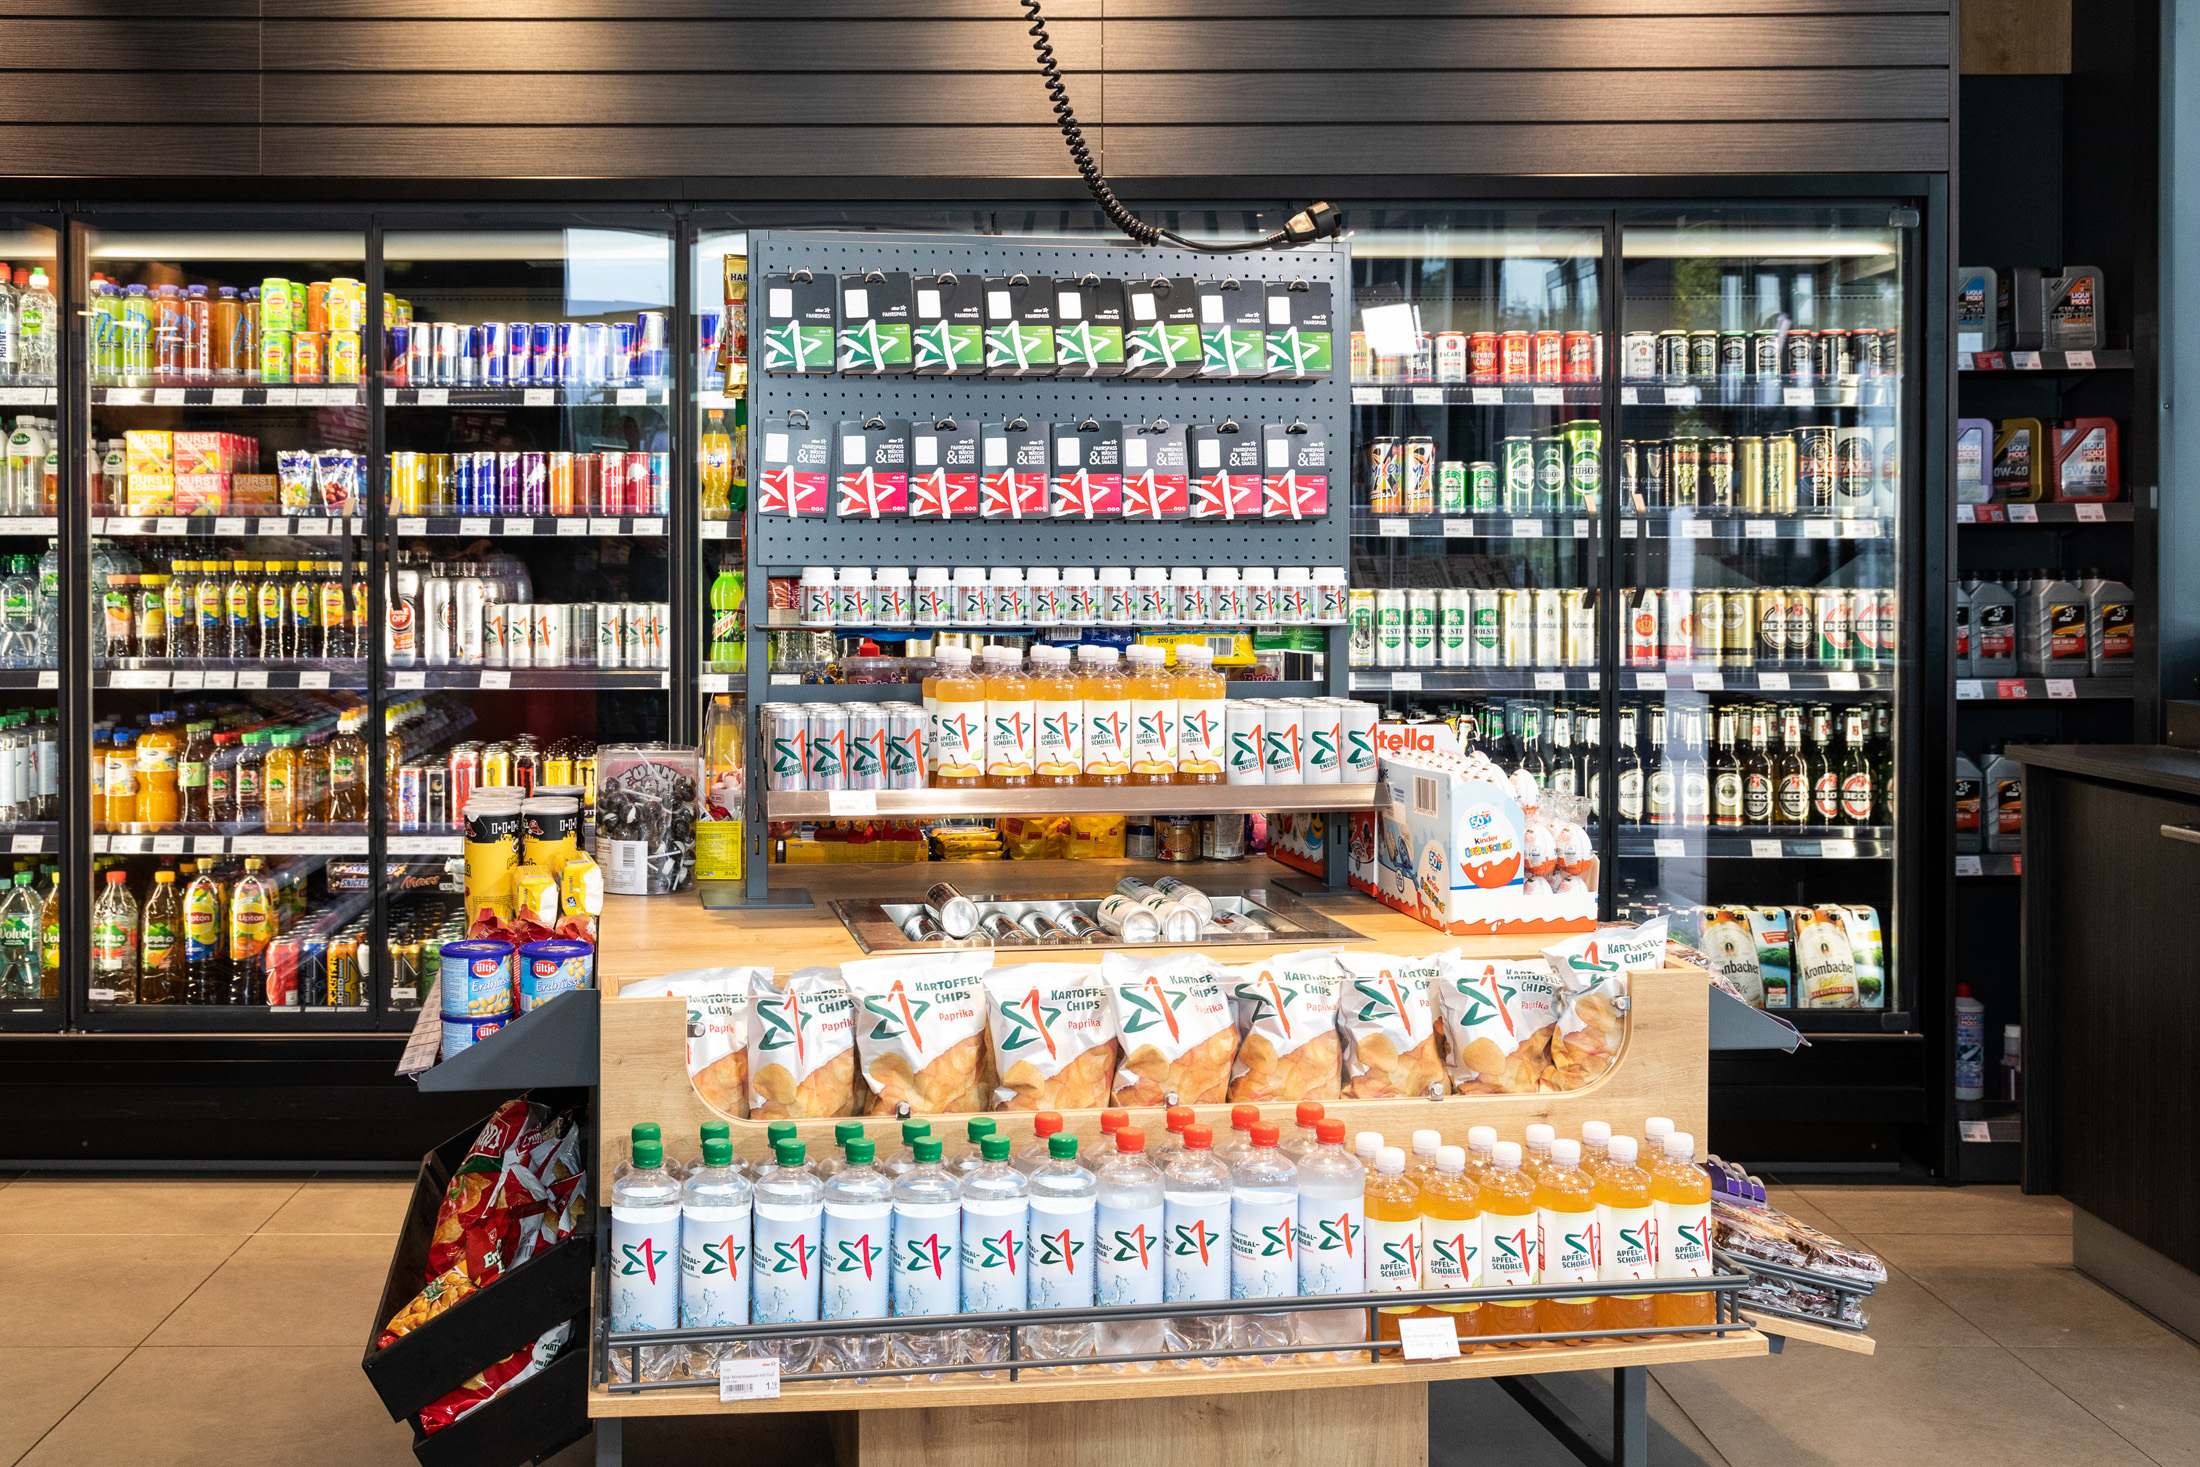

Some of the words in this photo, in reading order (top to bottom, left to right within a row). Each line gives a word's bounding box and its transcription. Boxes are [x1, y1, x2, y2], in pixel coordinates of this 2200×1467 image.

[730, 273, 747, 282] HAR
[22, 316, 43, 326] Volvic
[805, 312, 830, 320] FAHRSPASS
[1475, 358, 1492, 366] Club
[797, 450, 808, 464] &
[876, 450, 887, 464] &
[947, 451, 958, 464] &
[1017, 452, 1028, 465] &
[1089, 452, 1101, 465] &
[1570, 466, 1602, 475] TUBOR
[1801, 460, 1836, 474] FAXE
[1838, 461, 1872, 473] FAXE
[1994, 467, 2028, 477] 0W-40
[2064, 466, 2106, 476] 5W-40
[131, 475, 170, 484] DURST
[235, 477, 273, 485] DURST
[940, 740, 962, 748] SCHORLE
[994, 739, 1018, 748] SCHORLE
[1378, 728, 1435, 750] tella
[1243, 757, 1258, 765] PURE
[1279, 756, 1293, 764] PURE
[1325, 756, 1338, 764] PURE
[1356, 760, 1376, 769] ENERGY
[1360, 755, 1375, 764] PURE
[787, 763, 802, 771] PURE
[826, 763, 842, 772] PURE
[865, 762, 880, 771] PURE
[901, 761, 916, 770] PURE
[1238, 762, 1260, 772] ENERGY
[1274, 761, 1295, 770] ENERGY
[1320, 761, 1338, 770] ENERGY
[618, 764, 684, 790] FUNN
[782, 769, 803, 778] ENERGY
[821, 769, 842, 778] ENERGY
[860, 768, 882, 777] ENERGY
[896, 768, 918, 776] ENERGY
[400, 876, 440, 889] Mars
[238, 913, 265, 923] Lipton
[1608, 940, 1664, 954] KARTOFFEL-
[1624, 952, 1656, 964] CHIPS
[476, 964, 497, 974] ültje
[536, 964, 556, 974] ültje
[1804, 960, 1854, 980] Krombacher
[472, 977, 512, 992] Erdnüss
[536, 978, 583, 992] Erdnüsse
[916, 975, 982, 992] KARTOFFEL-
[1818, 973, 1847, 988] Radler
[1190, 986, 1218, 998] CHIPS
[1304, 984, 1332, 997] CHIPS
[1521, 981, 1553, 995] CHIPS
[1812, 986, 1854, 999] ALKOHOLFREI
[935, 991, 971, 1004] CHIPS
[818, 1000, 855, 1014] CHIPS
[1067, 1000, 1100, 1012] CHIPS
[1306, 1003, 1337, 1013] Paprika
[1521, 1001, 1550, 1011] Paprika
[939, 1009, 974, 1023] Paprika
[1068, 1019, 1101, 1031] Paprika
[1617, 1250, 1642, 1258] APFEL-
[1675, 1246, 1701, 1254] APFEL-
[1562, 1254, 1587, 1262] APFEL-
[1617, 1256, 1648, 1264] SCHORLE
[1675, 1252, 1705, 1260] SCHORLE
[1380, 1263, 1406, 1271] APFEL-
[1431, 1260, 1454, 1268] APFEL-
[1492, 1262, 1523, 1270] SCHORLE
[1562, 1260, 1592, 1269] SCHORLE
[1380, 1268, 1411, 1278] SCHORLE
[1431, 1267, 1461, 1275] SCHORLE
